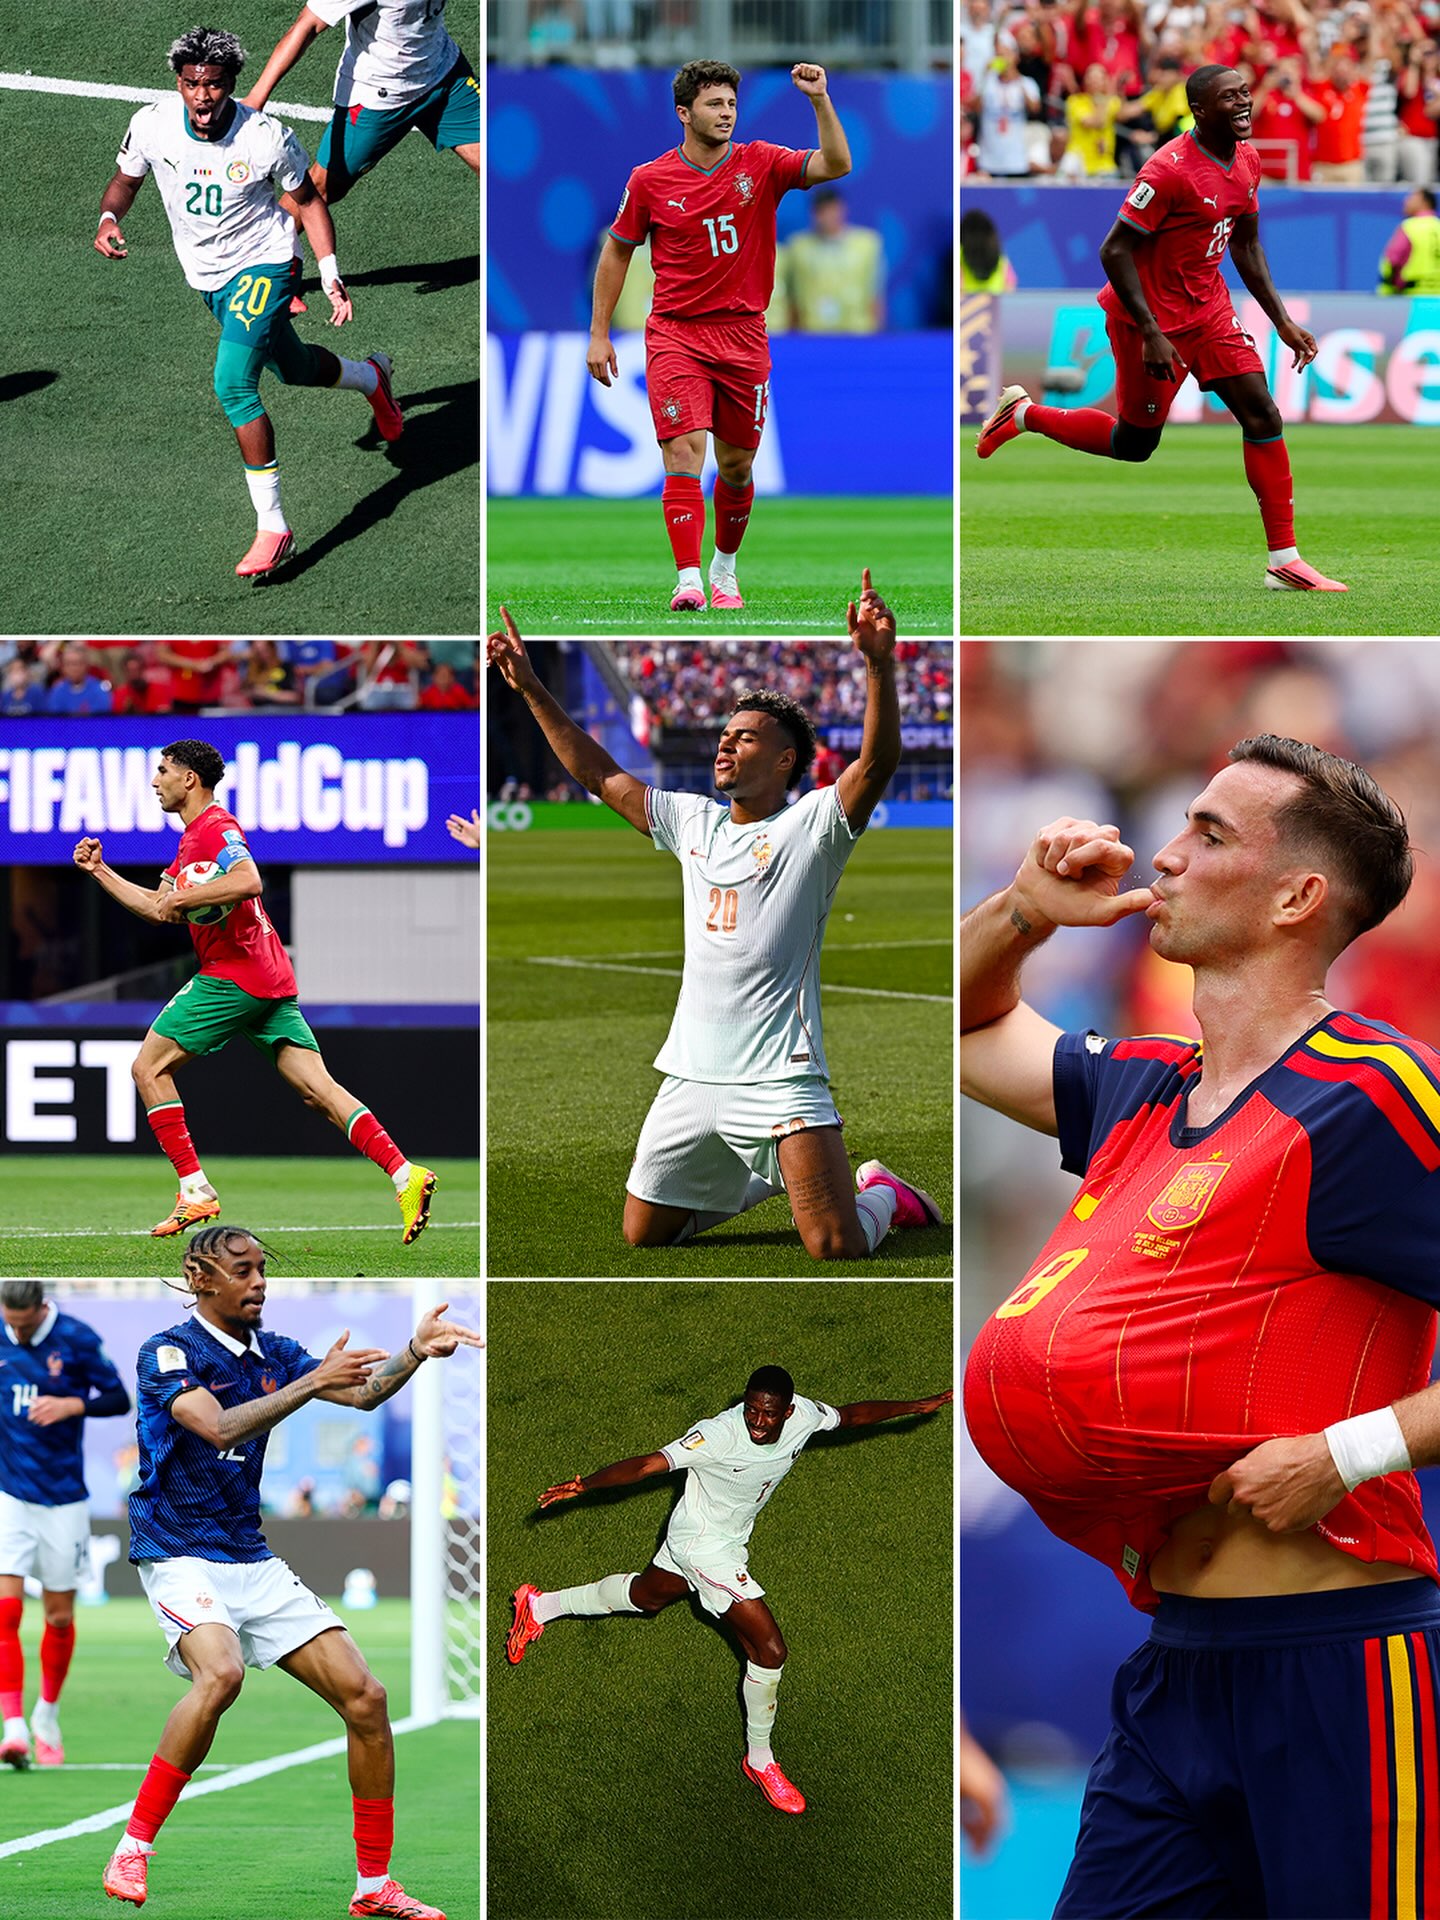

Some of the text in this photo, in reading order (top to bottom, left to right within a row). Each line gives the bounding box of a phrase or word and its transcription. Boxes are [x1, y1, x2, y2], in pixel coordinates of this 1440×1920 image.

[185, 182, 222, 216] 20
[702, 213, 739, 257] 15
[1205, 217, 1235, 258] 25
[229, 275, 272, 316] 20
[0, 742, 430, 848] IFAWrldCup
[706, 887, 738, 933] 20
[6, 1040, 146, 1142] ET
[996, 1248, 1088, 1319] 8
[11, 1384, 38, 1417] 14
